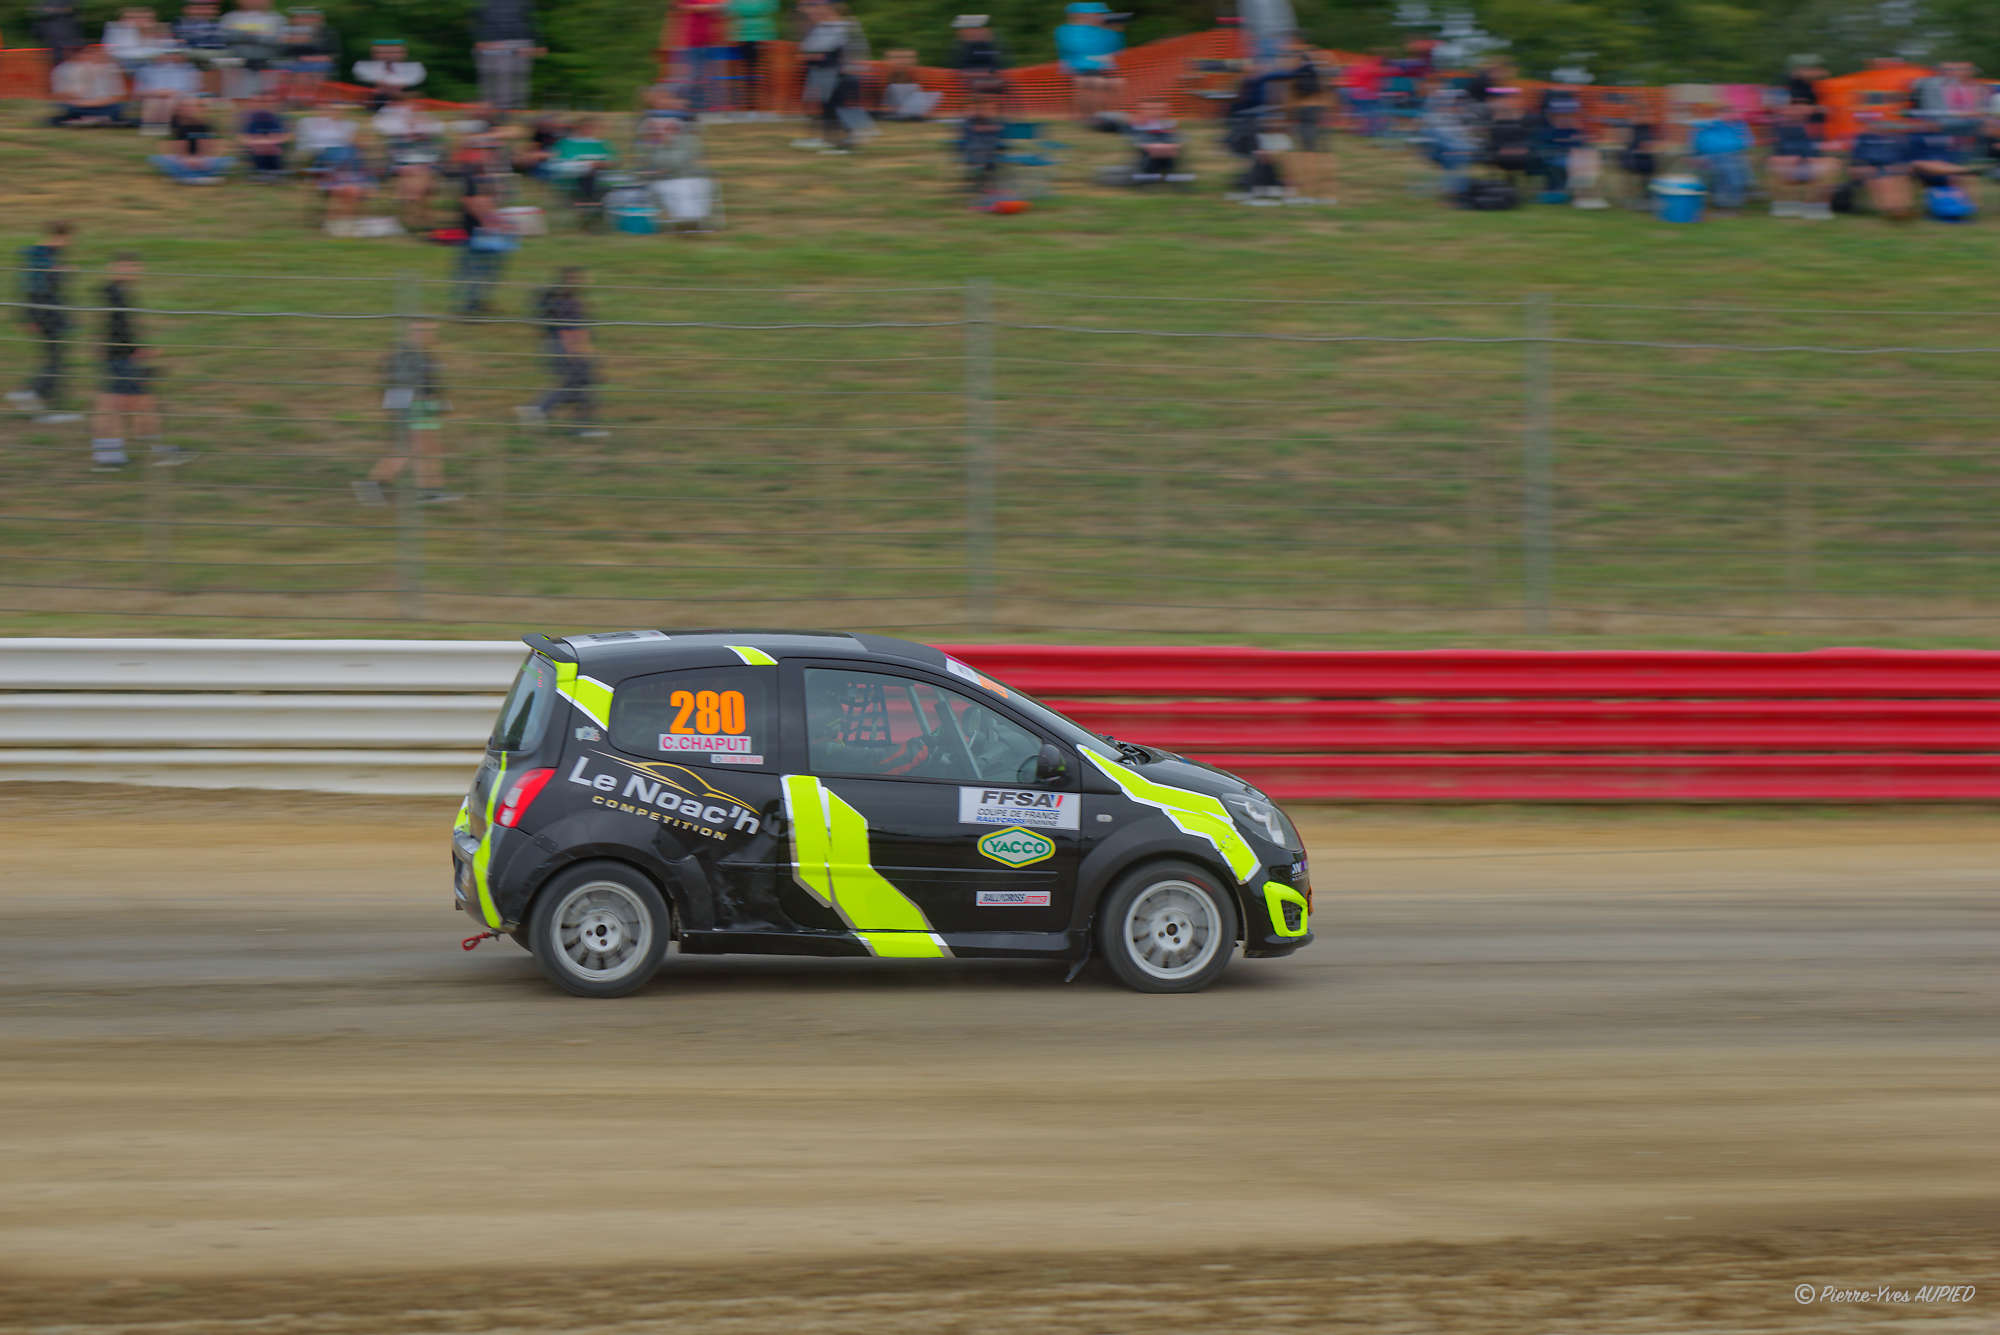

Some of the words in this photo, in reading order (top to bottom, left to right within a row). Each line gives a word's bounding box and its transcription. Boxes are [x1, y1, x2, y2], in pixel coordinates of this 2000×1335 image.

[669, 690, 746, 735] 280
[661, 736, 749, 751] C.CHAPUT
[568, 756, 618, 792] Le
[622, 774, 761, 836] Noac'h
[981, 790, 1053, 808] FFSA
[592, 795, 728, 841] COMPETITION
[977, 808, 1008, 817] COUPE
[1010, 810, 1022, 818] DE
[1024, 811, 1060, 820] FRANCE
[989, 841, 1046, 854] YACCO
